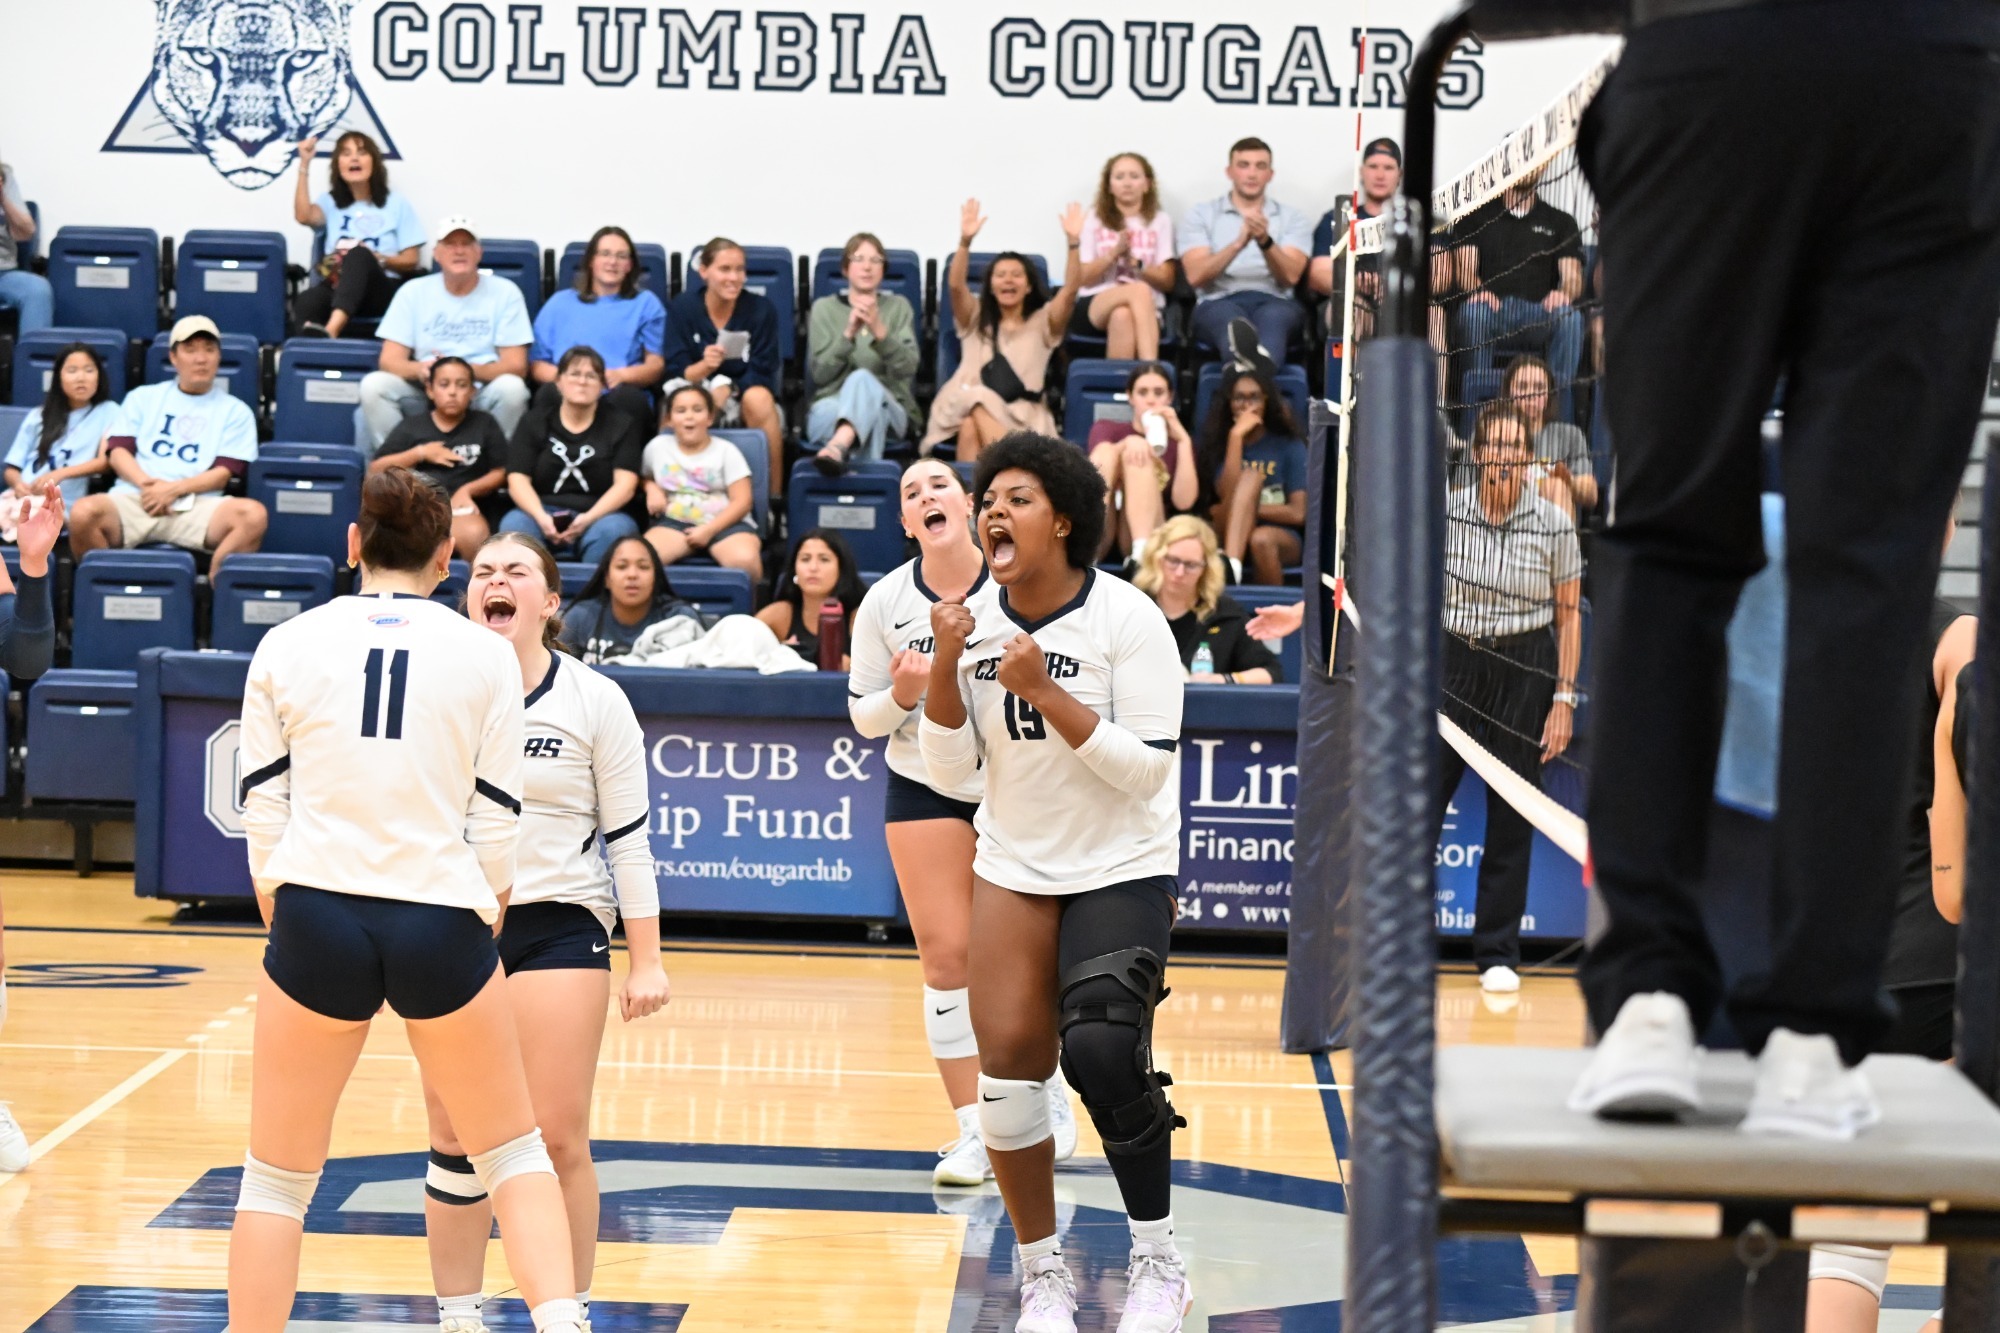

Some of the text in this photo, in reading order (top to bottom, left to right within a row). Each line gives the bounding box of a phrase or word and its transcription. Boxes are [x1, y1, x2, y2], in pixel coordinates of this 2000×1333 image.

[373, 1, 1485, 110] COLUMBIA COUGARS
[160, 414, 176, 436] I
[151, 440, 199, 463] CC
[360, 648, 409, 740] 11
[1004, 690, 1046, 741] 19
[825, 737, 874, 781] &
[722, 794, 853, 841] Fund
[1185, 879, 1199, 894] A
[1201, 880, 1263, 895] member
[1264, 881, 1284, 896] of
